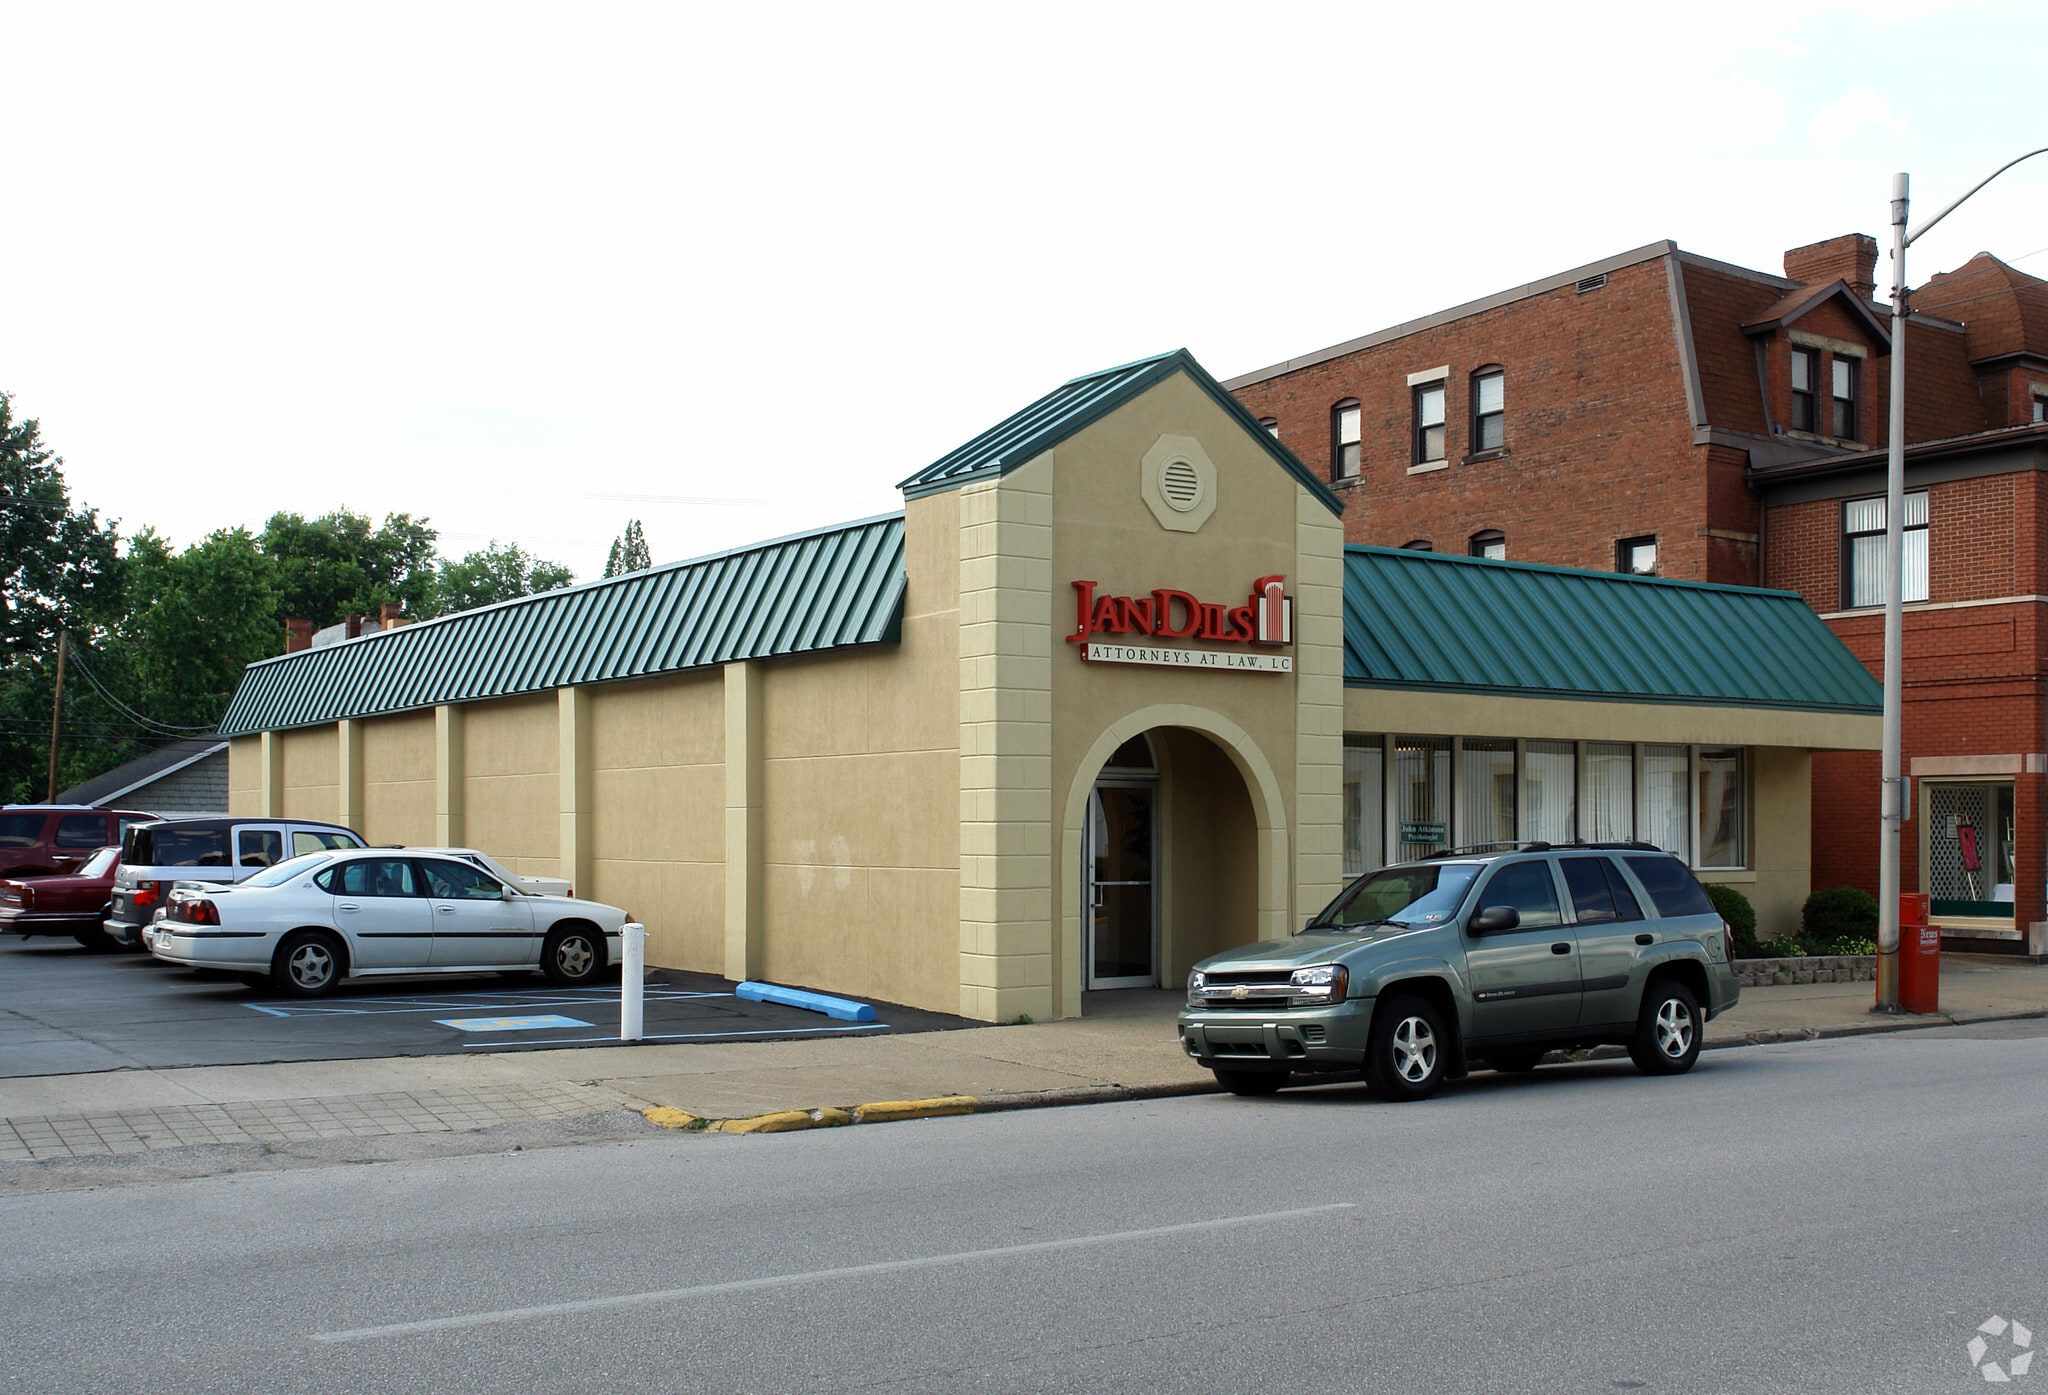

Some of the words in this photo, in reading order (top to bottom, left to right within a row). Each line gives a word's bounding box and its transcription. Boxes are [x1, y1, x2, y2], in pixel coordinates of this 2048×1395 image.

[1092, 646, 1190, 664] ATTORNEYS
[1200, 654, 1217, 665] AT
[1272, 658, 1290, 670] LC
[1402, 824, 1417, 833] John
